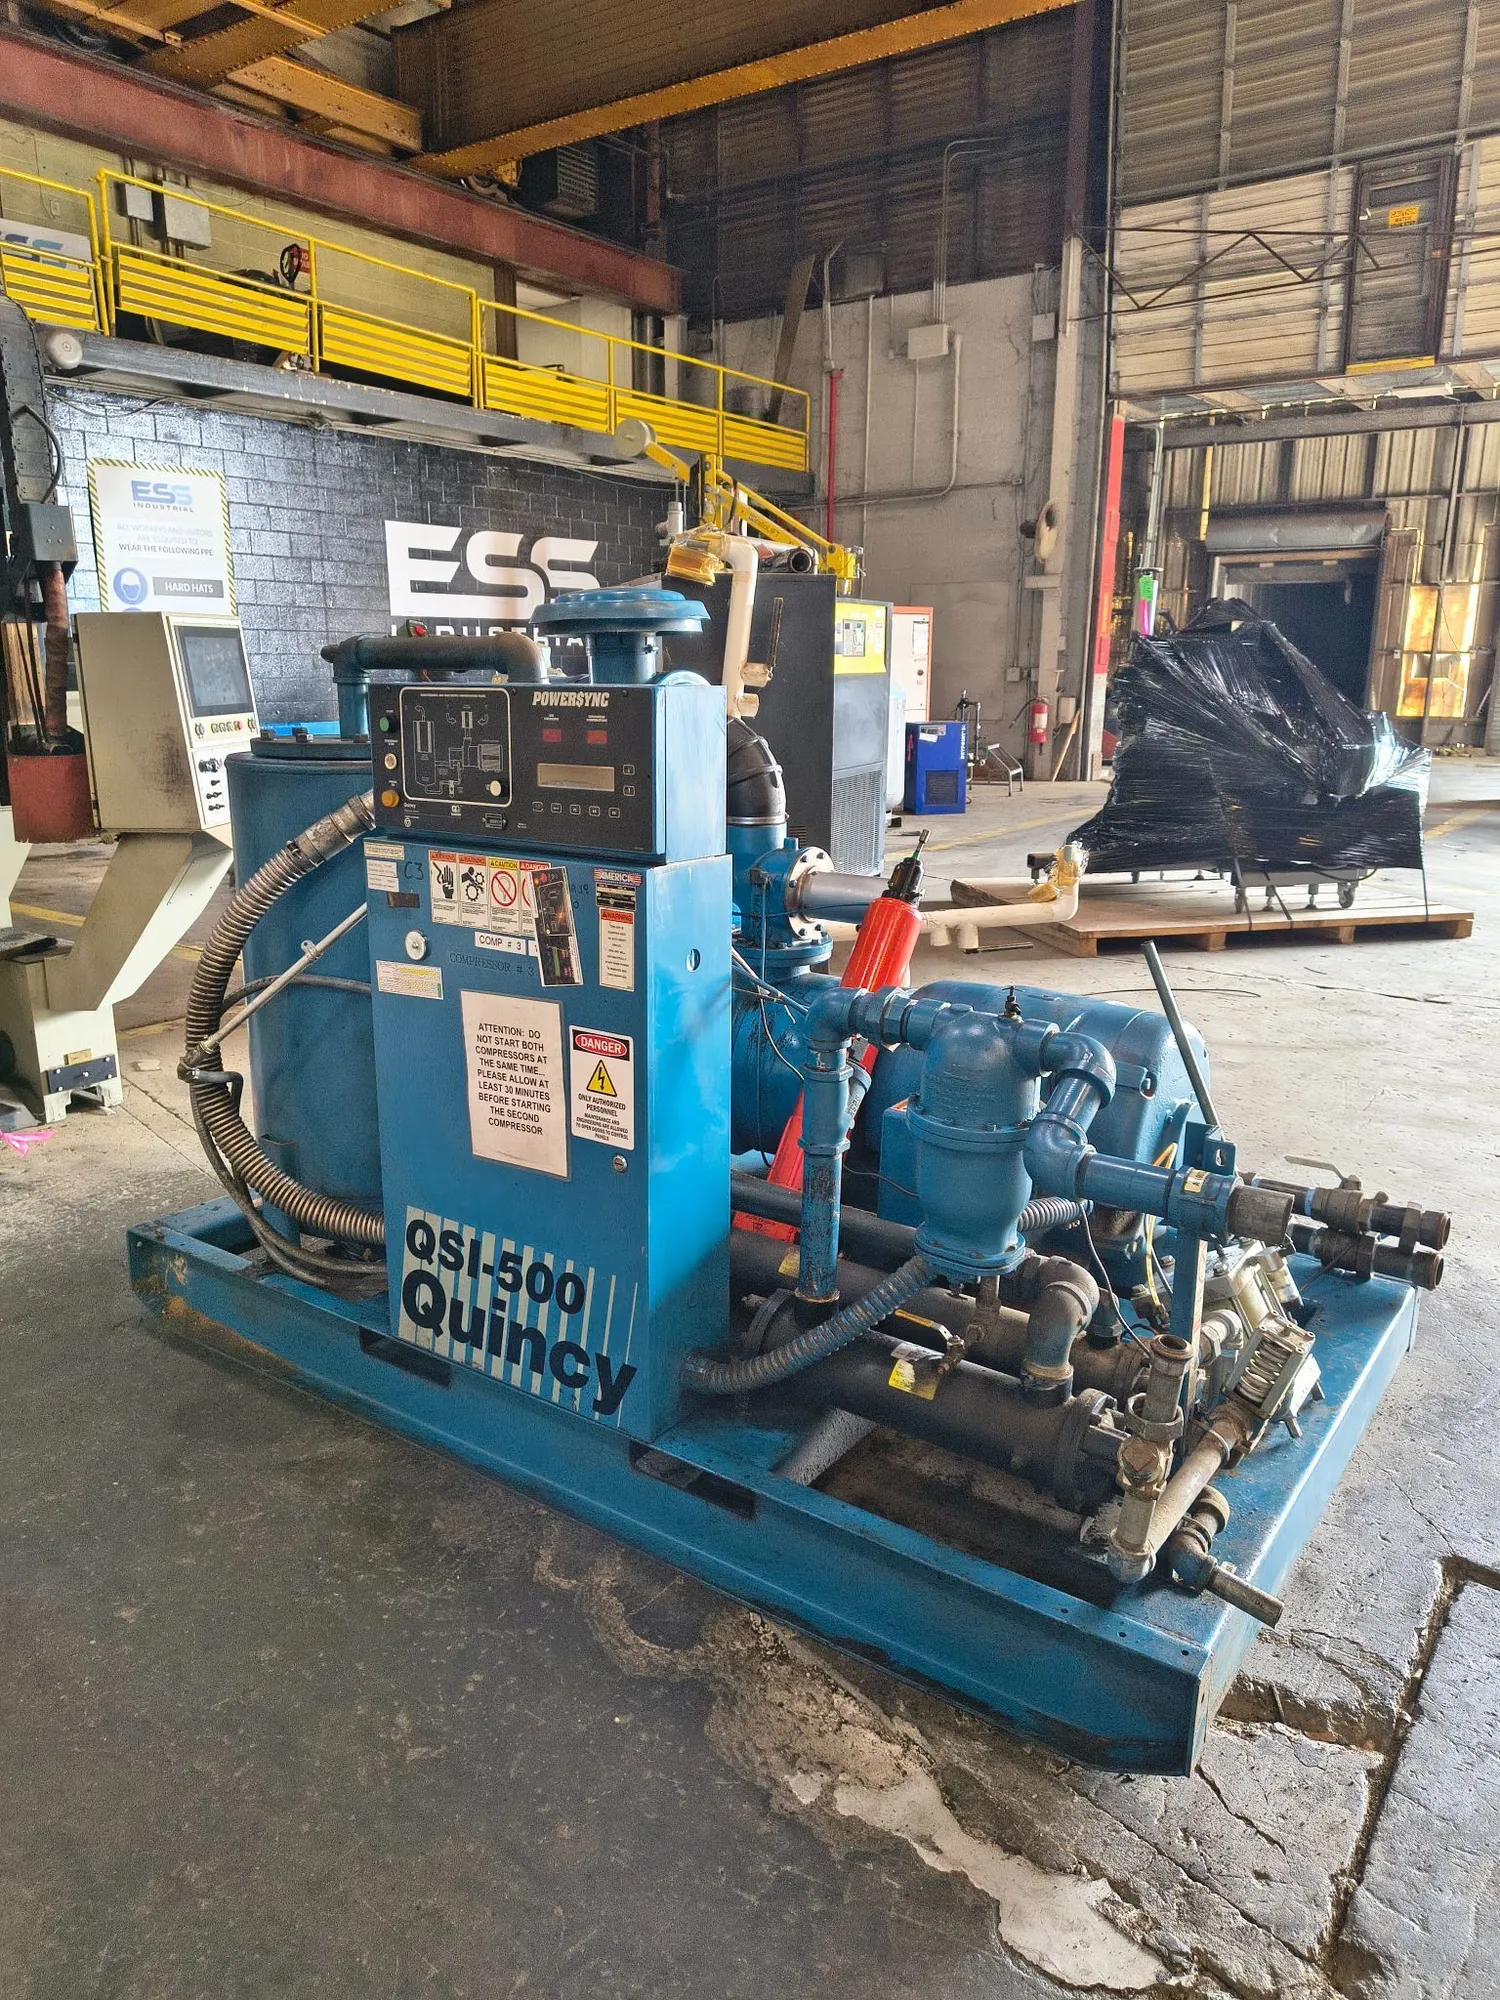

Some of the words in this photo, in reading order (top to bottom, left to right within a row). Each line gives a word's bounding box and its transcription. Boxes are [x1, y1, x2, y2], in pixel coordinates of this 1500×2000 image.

[131, 480, 194, 505] ESS
[133, 502, 195, 512] INDUSTRIAL
[131, 524, 167, 534] WORKERS
[137, 534, 152, 542] ARE
[188, 537, 199, 545] TO
[119, 543, 142, 551] WEAR
[158, 546, 200, 555] FOLLOWING
[385, 520, 601, 619] ESS
[164, 582, 191, 592] HARD
[192, 583, 214, 593] HATS
[404, 861, 424, 880] C3
[494, 860, 518, 869] CAUTION
[607, 912, 632, 922] WARNING
[479, 935, 502, 947] COMP
[450, 953, 511, 973] COMPRESSOR
[528, 967, 534, 977] 3
[478, 1023, 524, 1037] ATTENTION:
[528, 1030, 540, 1039] DO
[476, 1034, 492, 1044] NOT
[494, 1037, 520, 1048] START
[522, 1041, 544, 1052] BOTH
[580, 1036, 621, 1054] DANGER
[475, 1046, 535, 1063] COMPRESSORS
[537, 1055, 547, 1064] AT
[480, 1057, 494, 1068] THE
[496, 1060, 518, 1072] SAME
[477, 1069, 507, 1081] PLEASE
[509, 1075, 537, 1086] ALLOW
[539, 1080, 549, 1089] AT
[478, 1080, 503, 1092] LEAST
[504, 1085, 513, 1094] 30
[515, 1087, 550, 1101] MINUTES
[478, 1092, 509, 1106] BEFORE
[511, 1098, 551, 1113] STARTING
[578, 1093, 592, 1102] ONLY
[592, 1097, 626, 1110] AUTHORIZED
[586, 1103, 618, 1117] PERSONNEL
[490, 1106, 504, 1116] THE
[507, 1108, 539, 1123] SECOND
[584, 1112, 611, 1123] MAINTENANCE
[488, 1117, 543, 1135] COMPRESSOR
[576, 1117, 602, 1127] ENGINEERING
[610, 1125, 628, 1134] ALLOWED
[406, 1219, 585, 1315] QSI-500
[402, 1269, 638, 1416] Quincy
